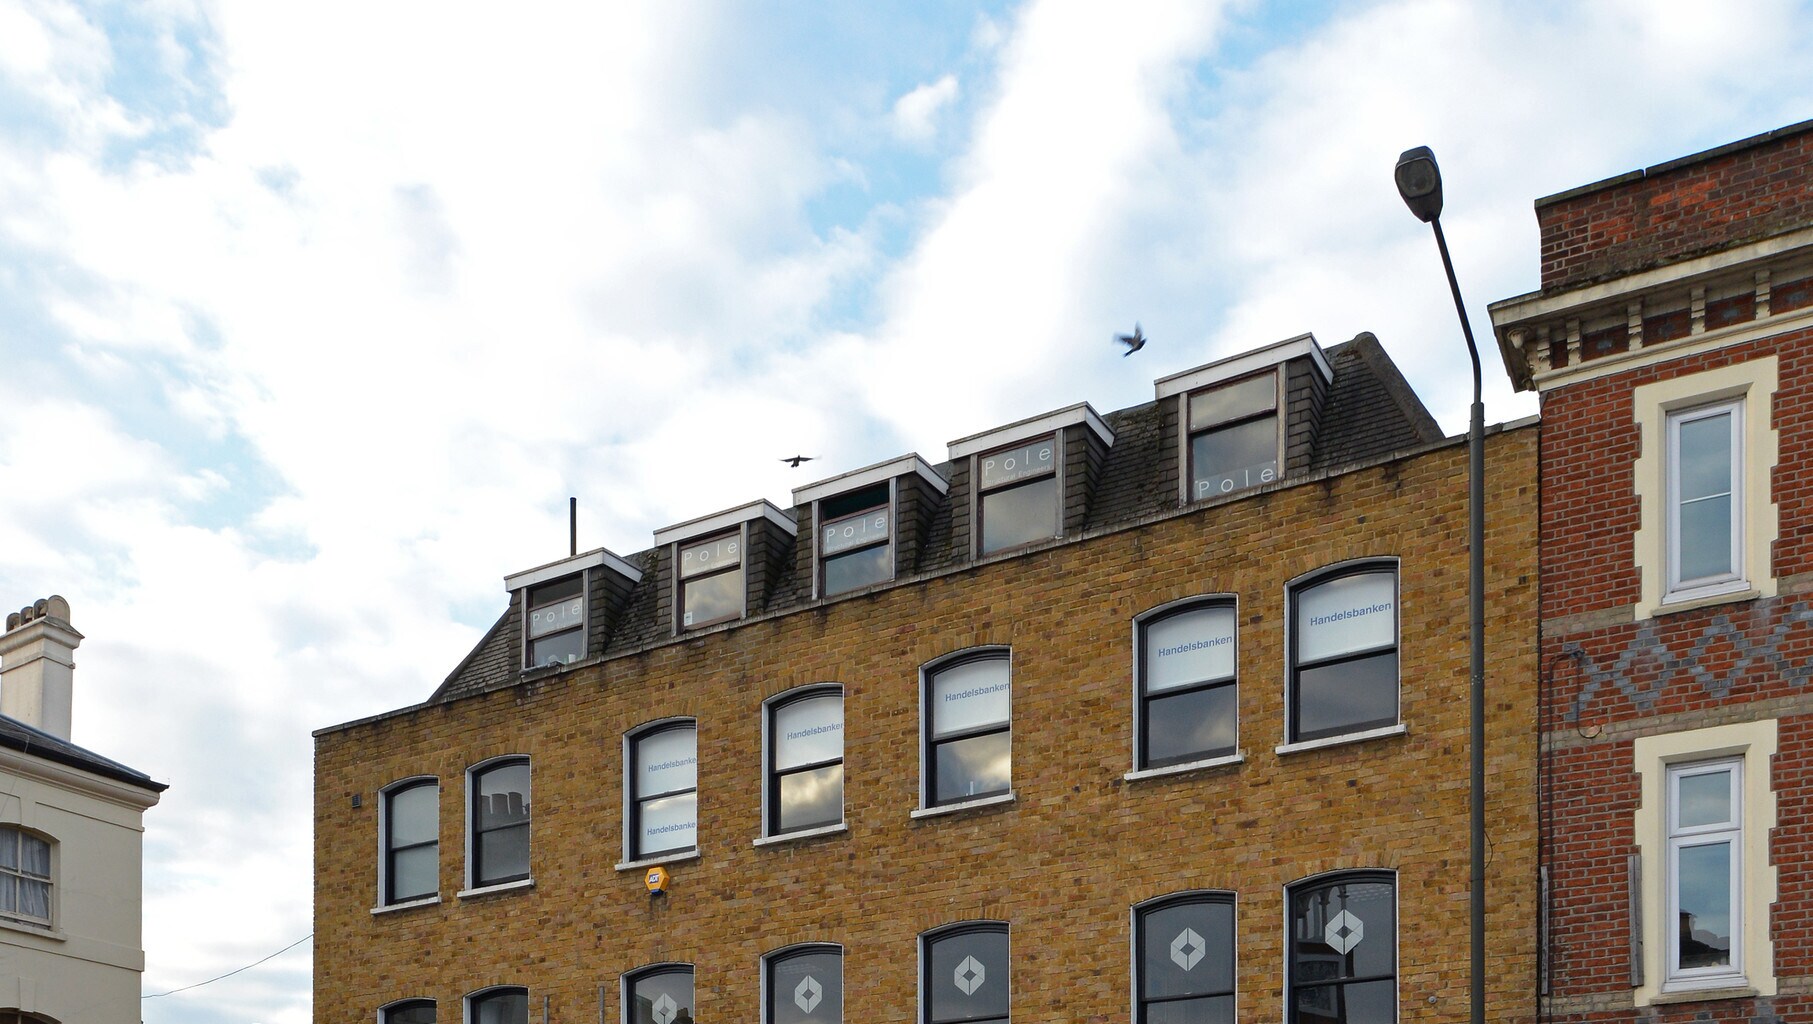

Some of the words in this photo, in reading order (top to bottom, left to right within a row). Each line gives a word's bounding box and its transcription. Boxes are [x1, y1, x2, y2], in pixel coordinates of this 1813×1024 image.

[985, 448, 1051, 477] Pole
[1199, 468, 1274, 499] Pole
[827, 517, 886, 543] Pole
[684, 542, 737, 567] Pole
[532, 604, 580, 627] Pole
[1310, 602, 1392, 627] Handelsbanken
[1158, 635, 1233, 657] Handelsbanken
[945, 682, 1010, 702] Handelsbanken
[648, 757, 696, 772] Handelsbanke
[647, 821, 696, 836] Handelsbanke
